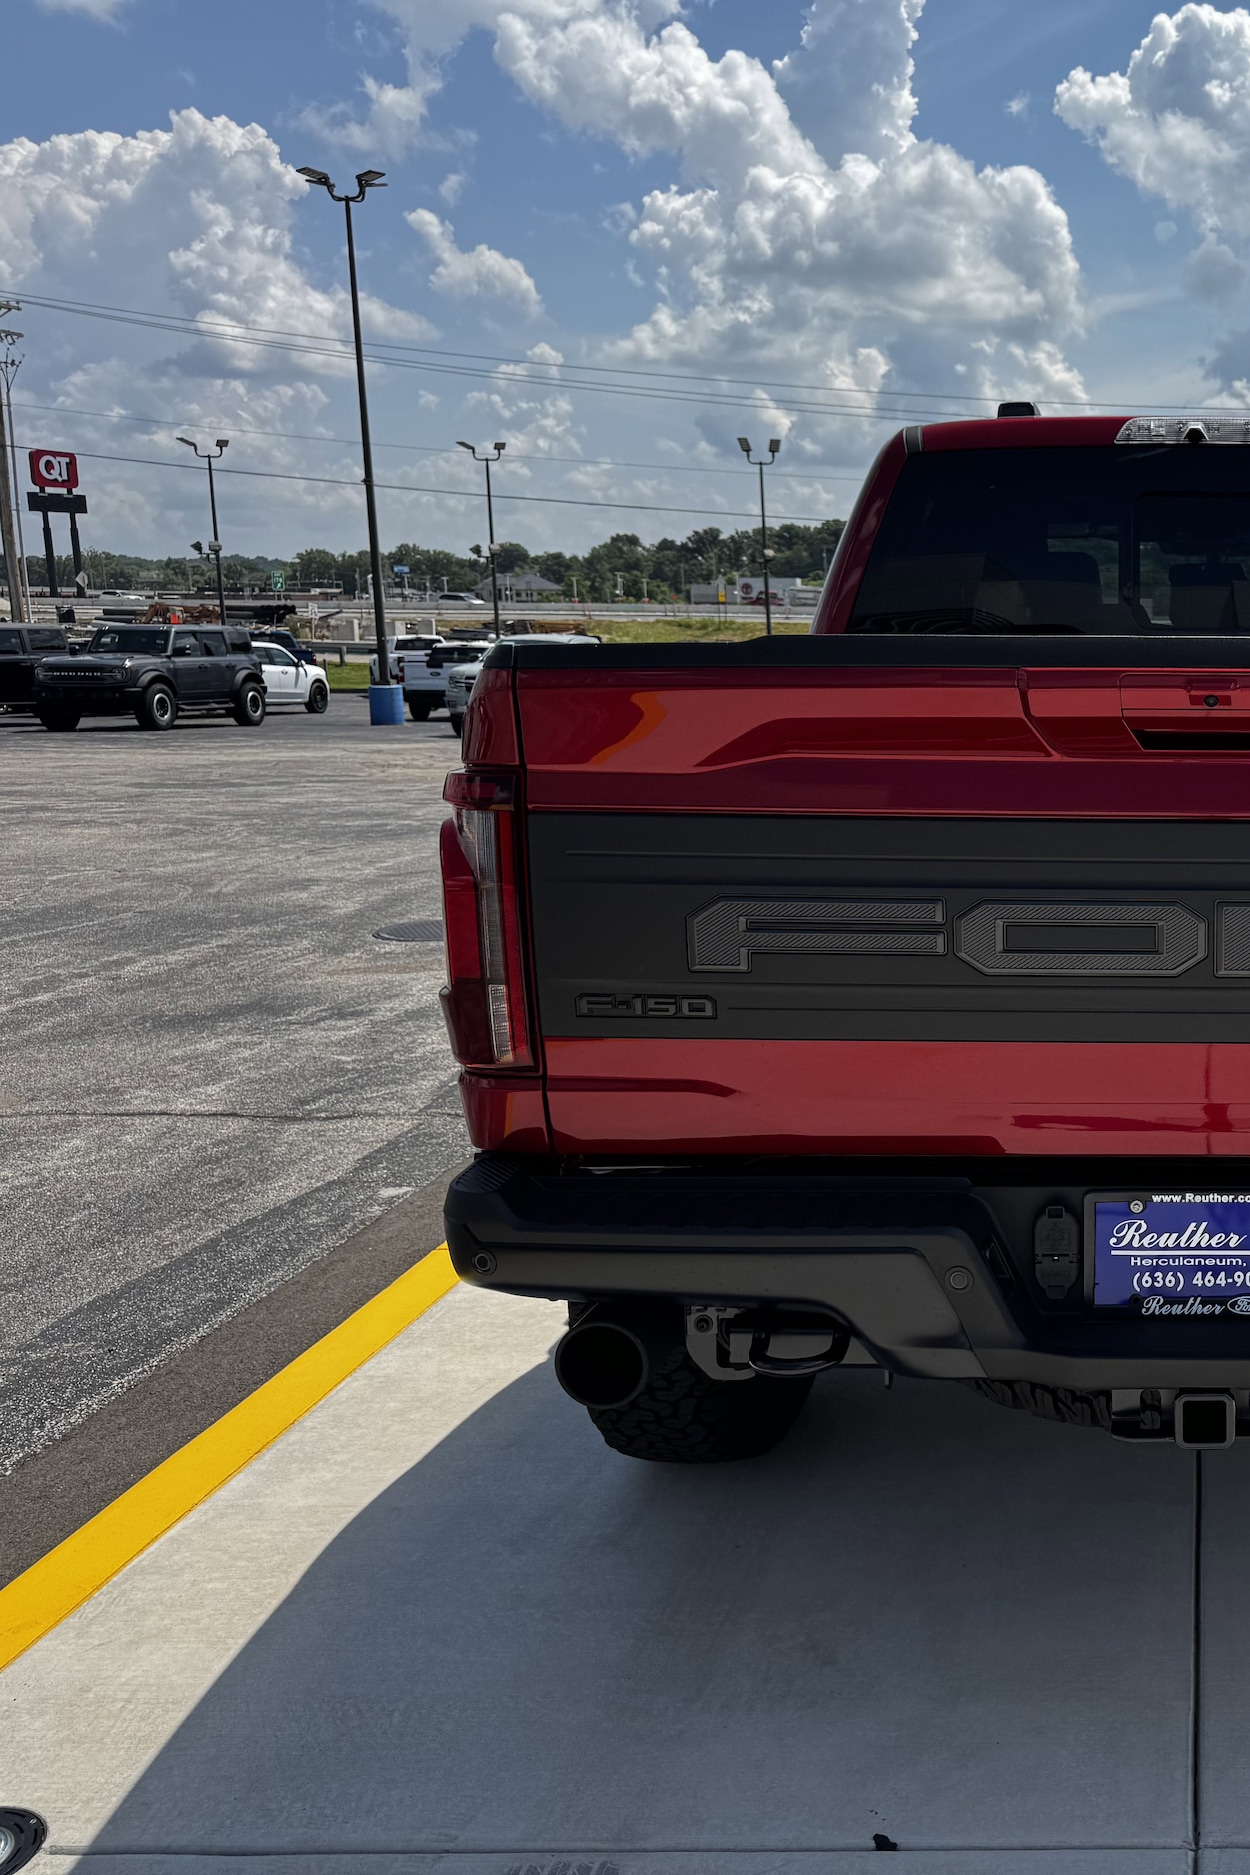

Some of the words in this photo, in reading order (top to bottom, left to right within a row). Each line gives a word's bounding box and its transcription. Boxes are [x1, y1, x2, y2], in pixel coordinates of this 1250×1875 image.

[39, 455, 70, 482] QT
[576, 994, 716, 1018] F-150
[1109, 1219, 1248, 1248] Reuther
[1130, 1256, 1247, 1267] Herculaneum,
[1132, 1271, 1185, 1292] (636)
[1141, 1295, 1226, 1315] Reuther
